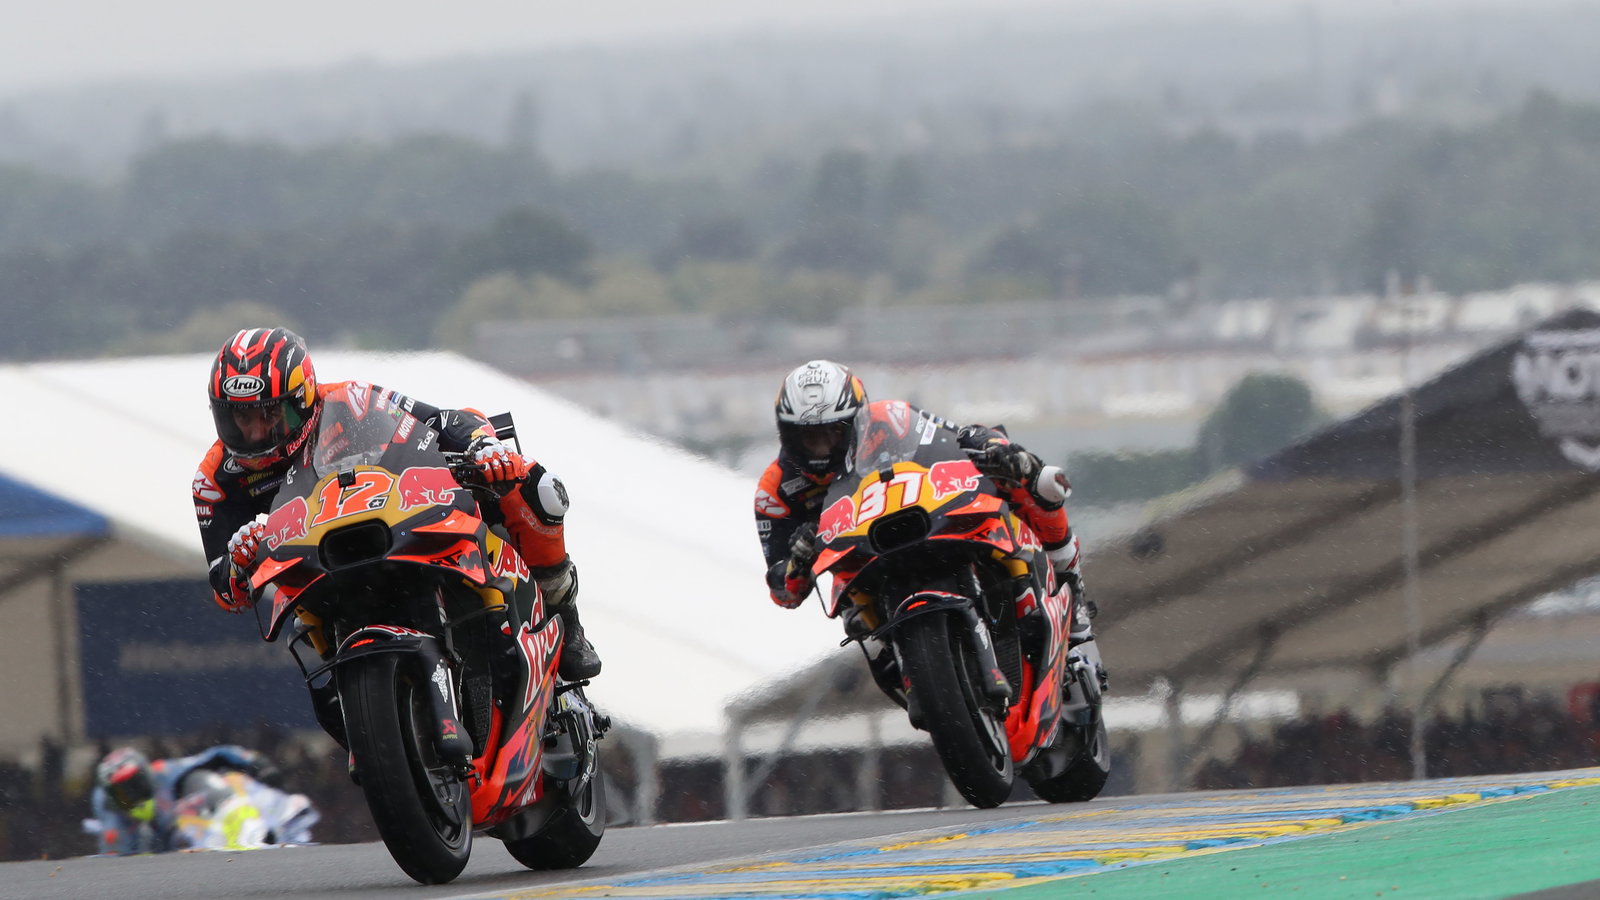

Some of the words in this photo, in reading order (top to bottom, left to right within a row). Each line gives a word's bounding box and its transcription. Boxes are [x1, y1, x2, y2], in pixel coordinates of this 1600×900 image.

[226, 378, 258, 390] Arai
[286, 425, 308, 456] Red
[397, 414, 415, 440] MOTUL
[310, 471, 395, 528] 12
[856, 471, 928, 527] 37
